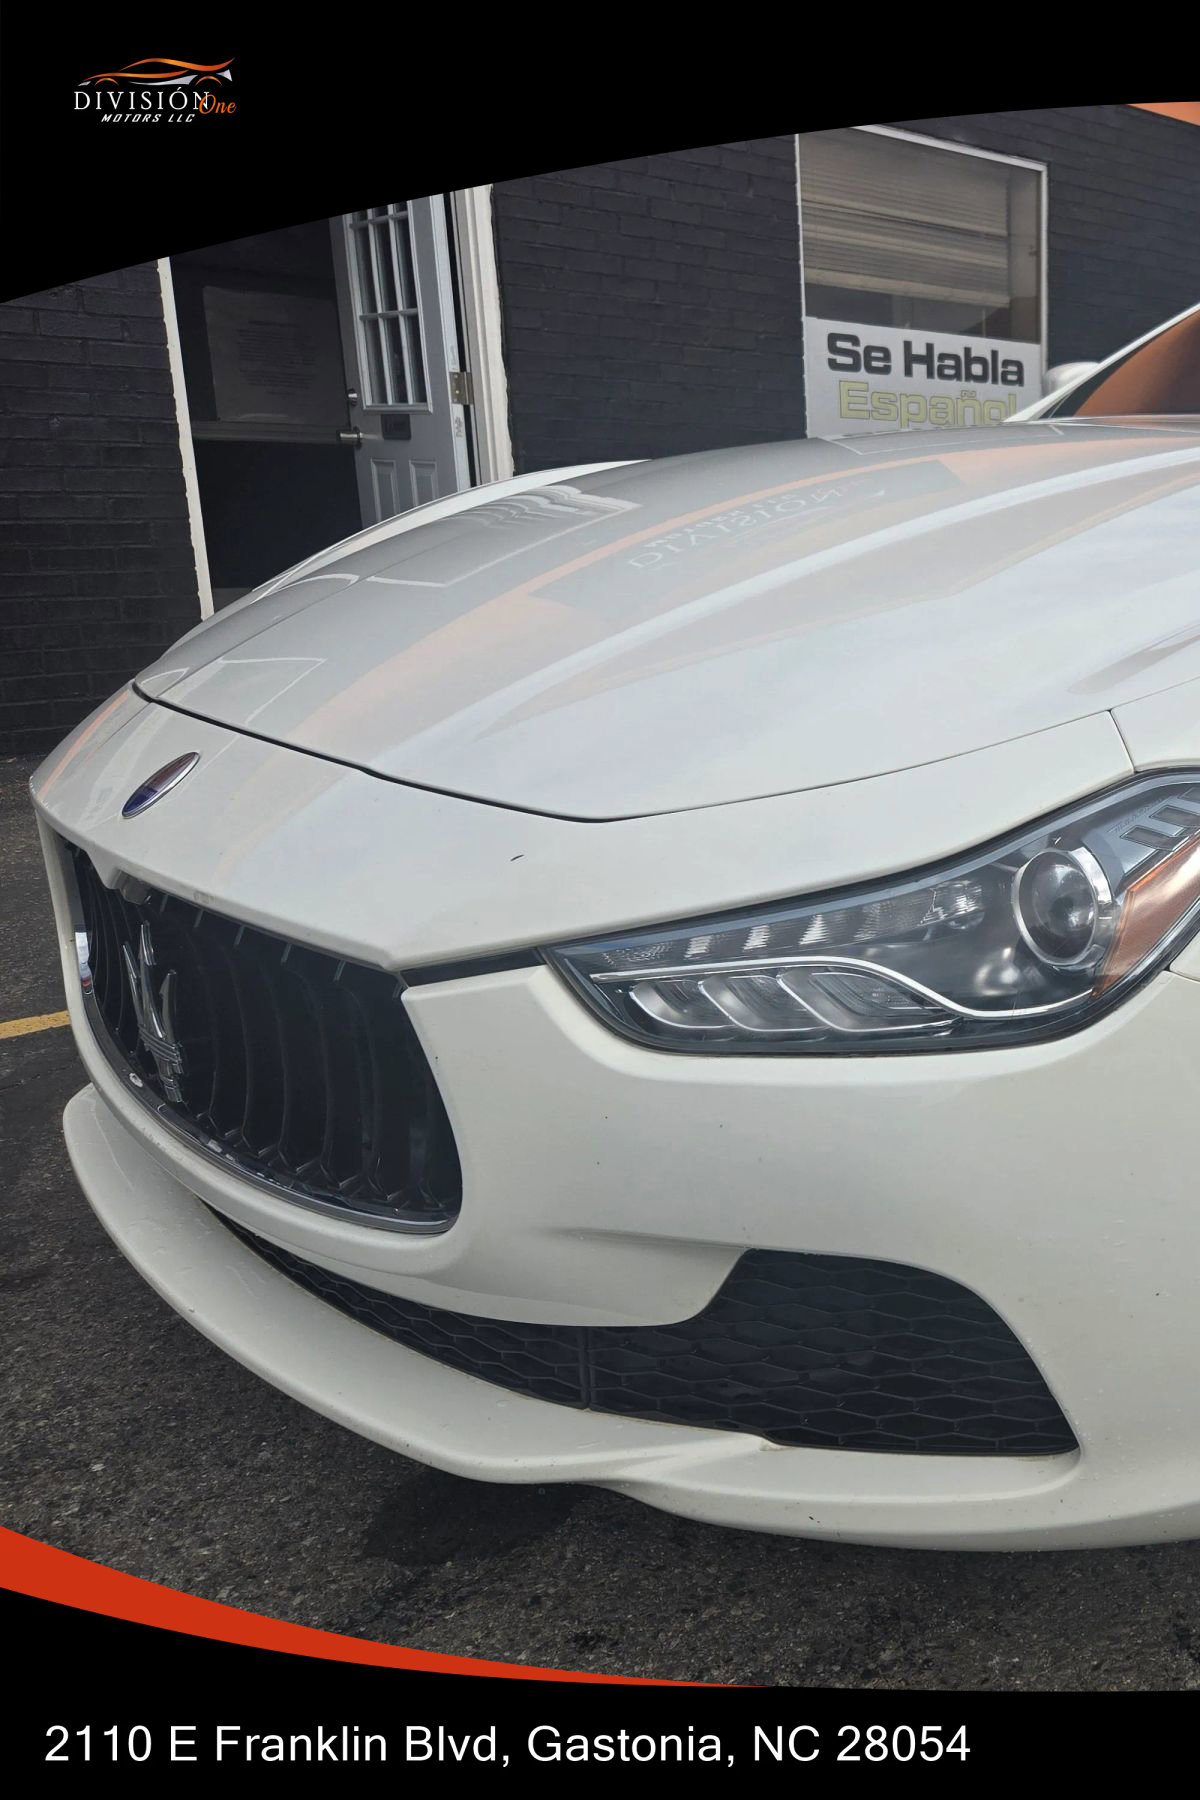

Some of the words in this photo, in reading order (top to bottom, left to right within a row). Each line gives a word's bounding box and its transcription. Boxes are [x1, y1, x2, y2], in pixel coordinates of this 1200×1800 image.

[827, 332, 892, 376] Se
[902, 340, 1025, 387] Habla
[838, 379, 1017, 430] Español
